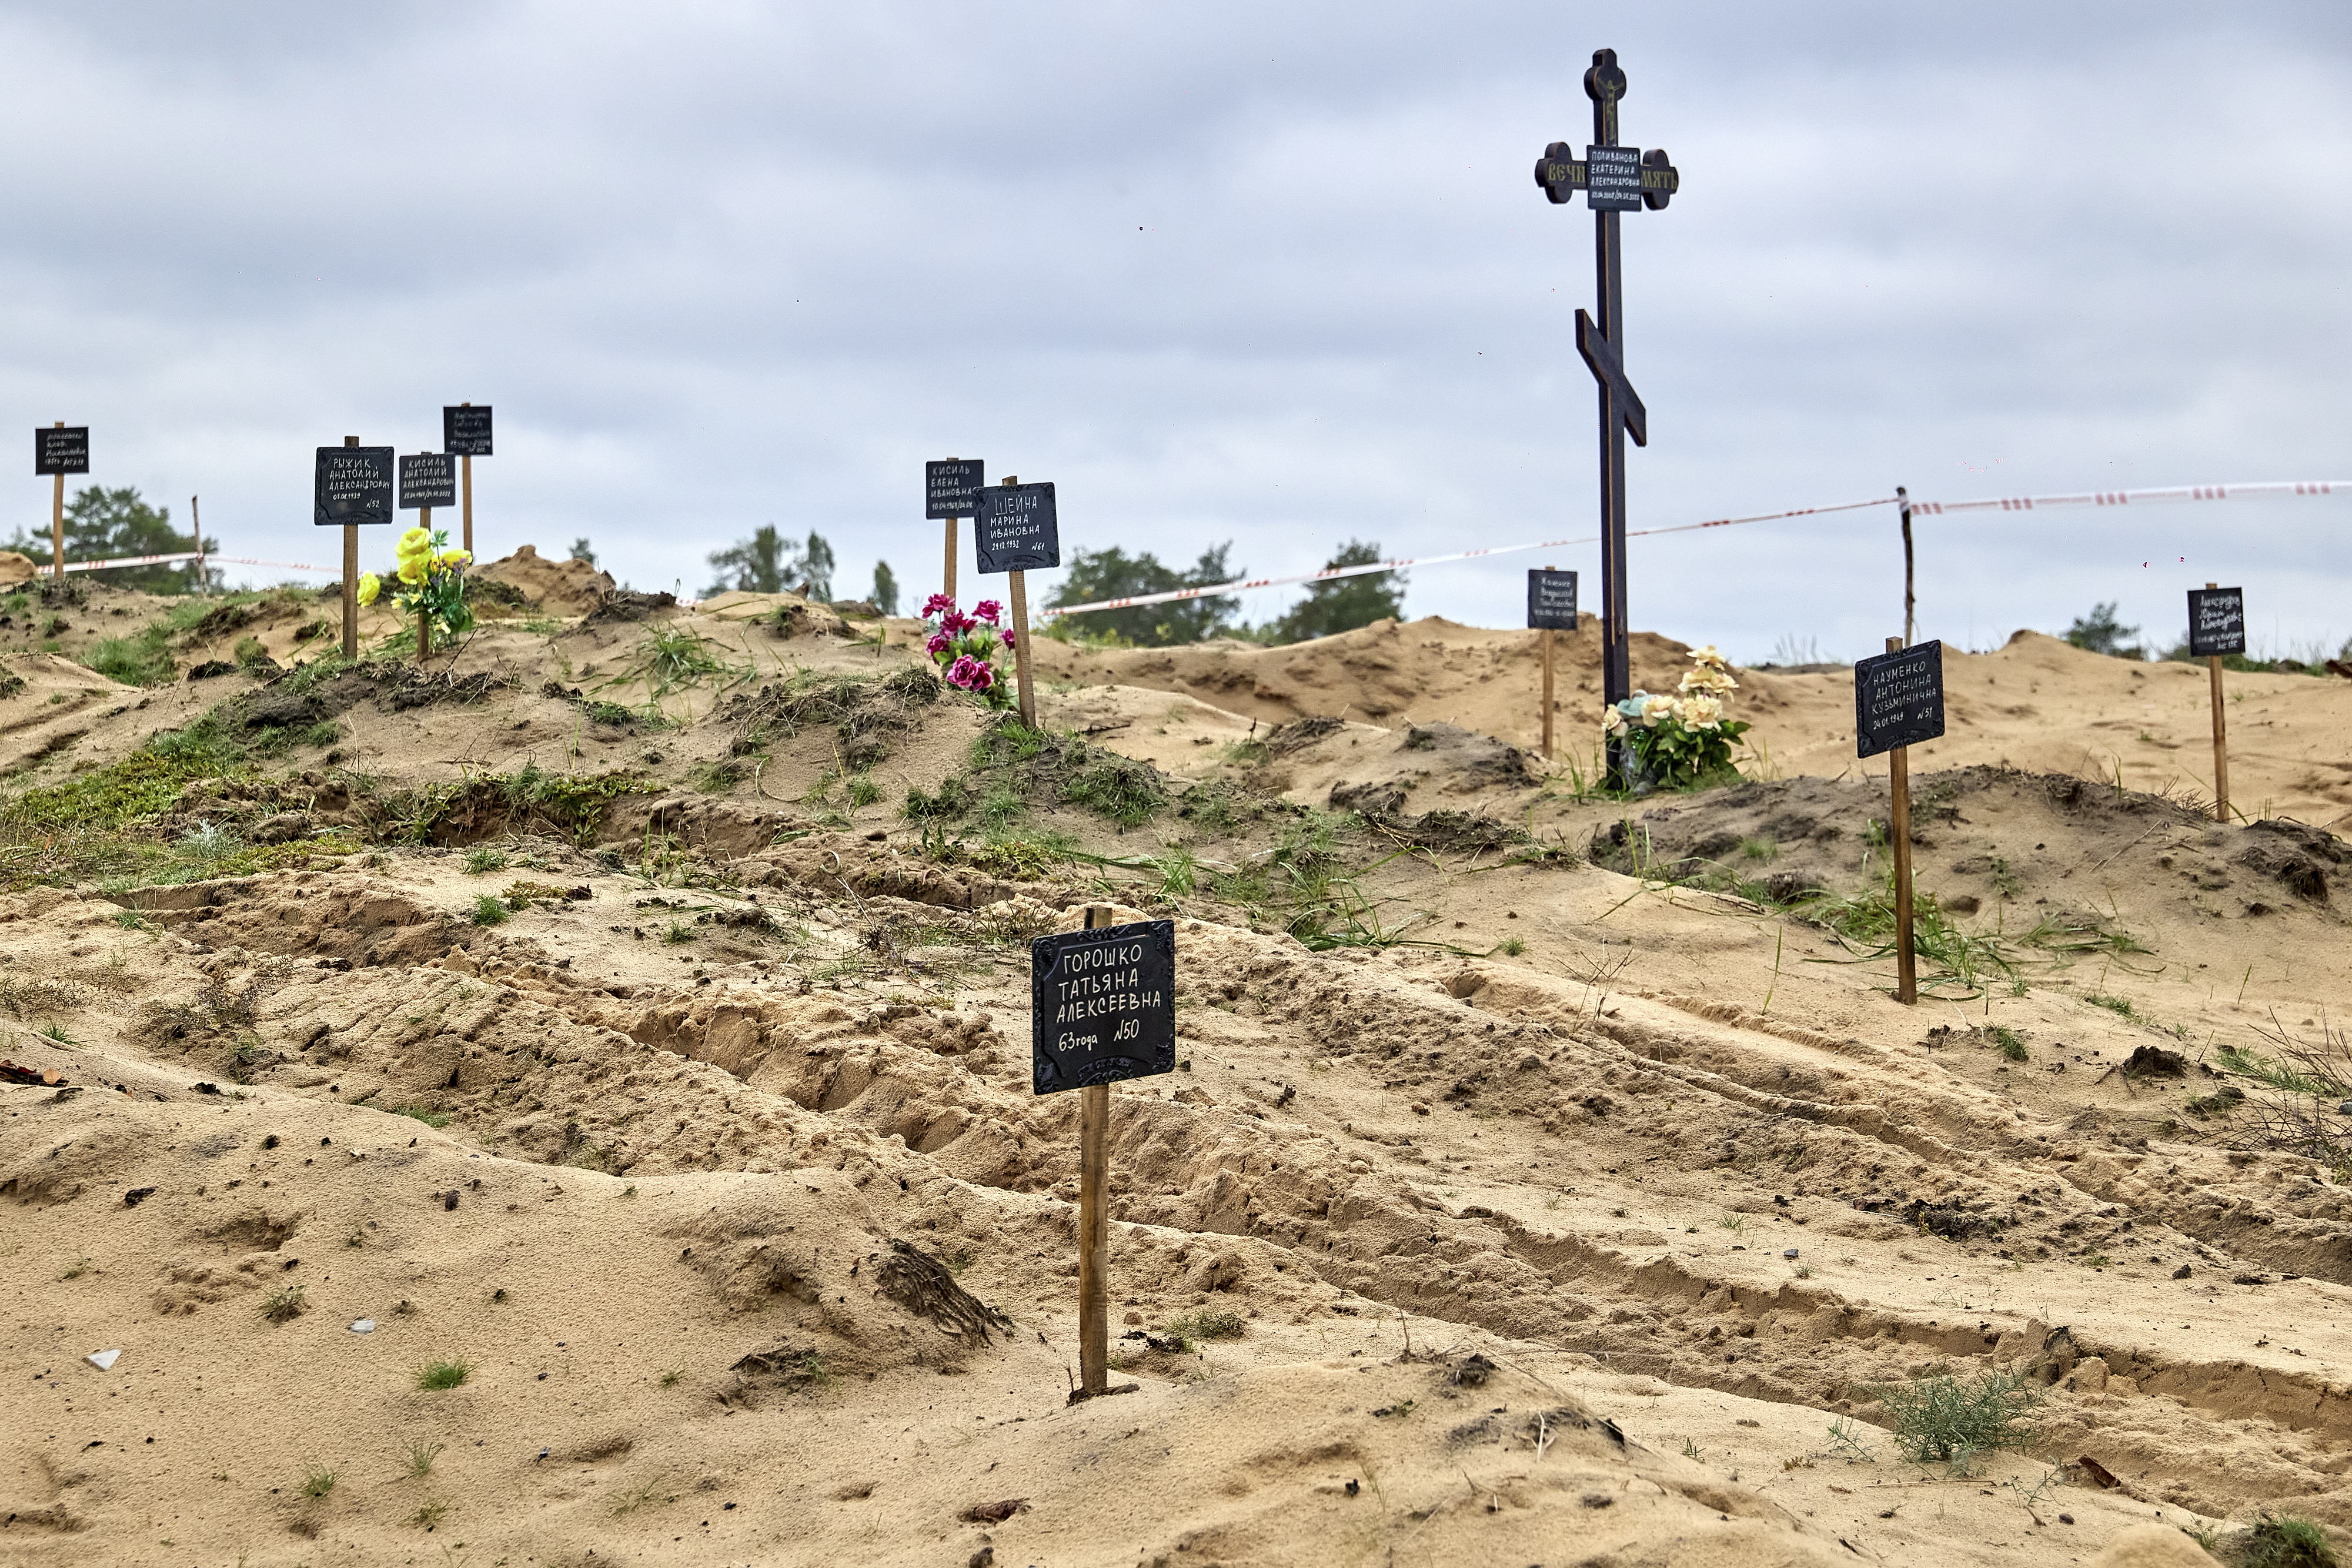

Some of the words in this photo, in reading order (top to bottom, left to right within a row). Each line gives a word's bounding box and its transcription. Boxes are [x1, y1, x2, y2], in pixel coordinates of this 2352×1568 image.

[1591, 151, 1638, 163] ПОЛИВАНОВА
[1548, 163, 1586, 183] ВЕЧН
[1641, 170, 1677, 189] МЯТЬ
[1591, 164, 1635, 176] ЕКАТЕРИНА
[333, 458, 370, 469] РЫЖИК
[409, 457, 446, 469] КИСИЛЬ
[329, 466, 379, 480] АНАТОЛИЙ
[404, 466, 447, 479] АНАТОЛИЙ
[933, 465, 970, 476] КИСИЛЬ
[329, 480, 390, 491] АЛЕКСАНДРОВИЧ
[931, 477, 959, 487] ЕЛЕНА
[931, 487, 972, 498] ИВАНОВНА
[995, 494, 1037, 516] ШЕЙНА
[990, 514, 1028, 527] МАРИНА
[990, 524, 1040, 539] ИВАНОВНА
[1873, 661, 1926, 686] НАУМЕНКО
[1876, 674, 1931, 701] АНТОНИНА
[1872, 688, 1936, 716] КУЗЬМИНИЧНА
[1064, 944, 1142, 974] ГОРОШКО
[1058, 968, 1138, 1001] ТАТЬЯНА
[1057, 990, 1161, 1024] АЛЕКСЕЕВНА
